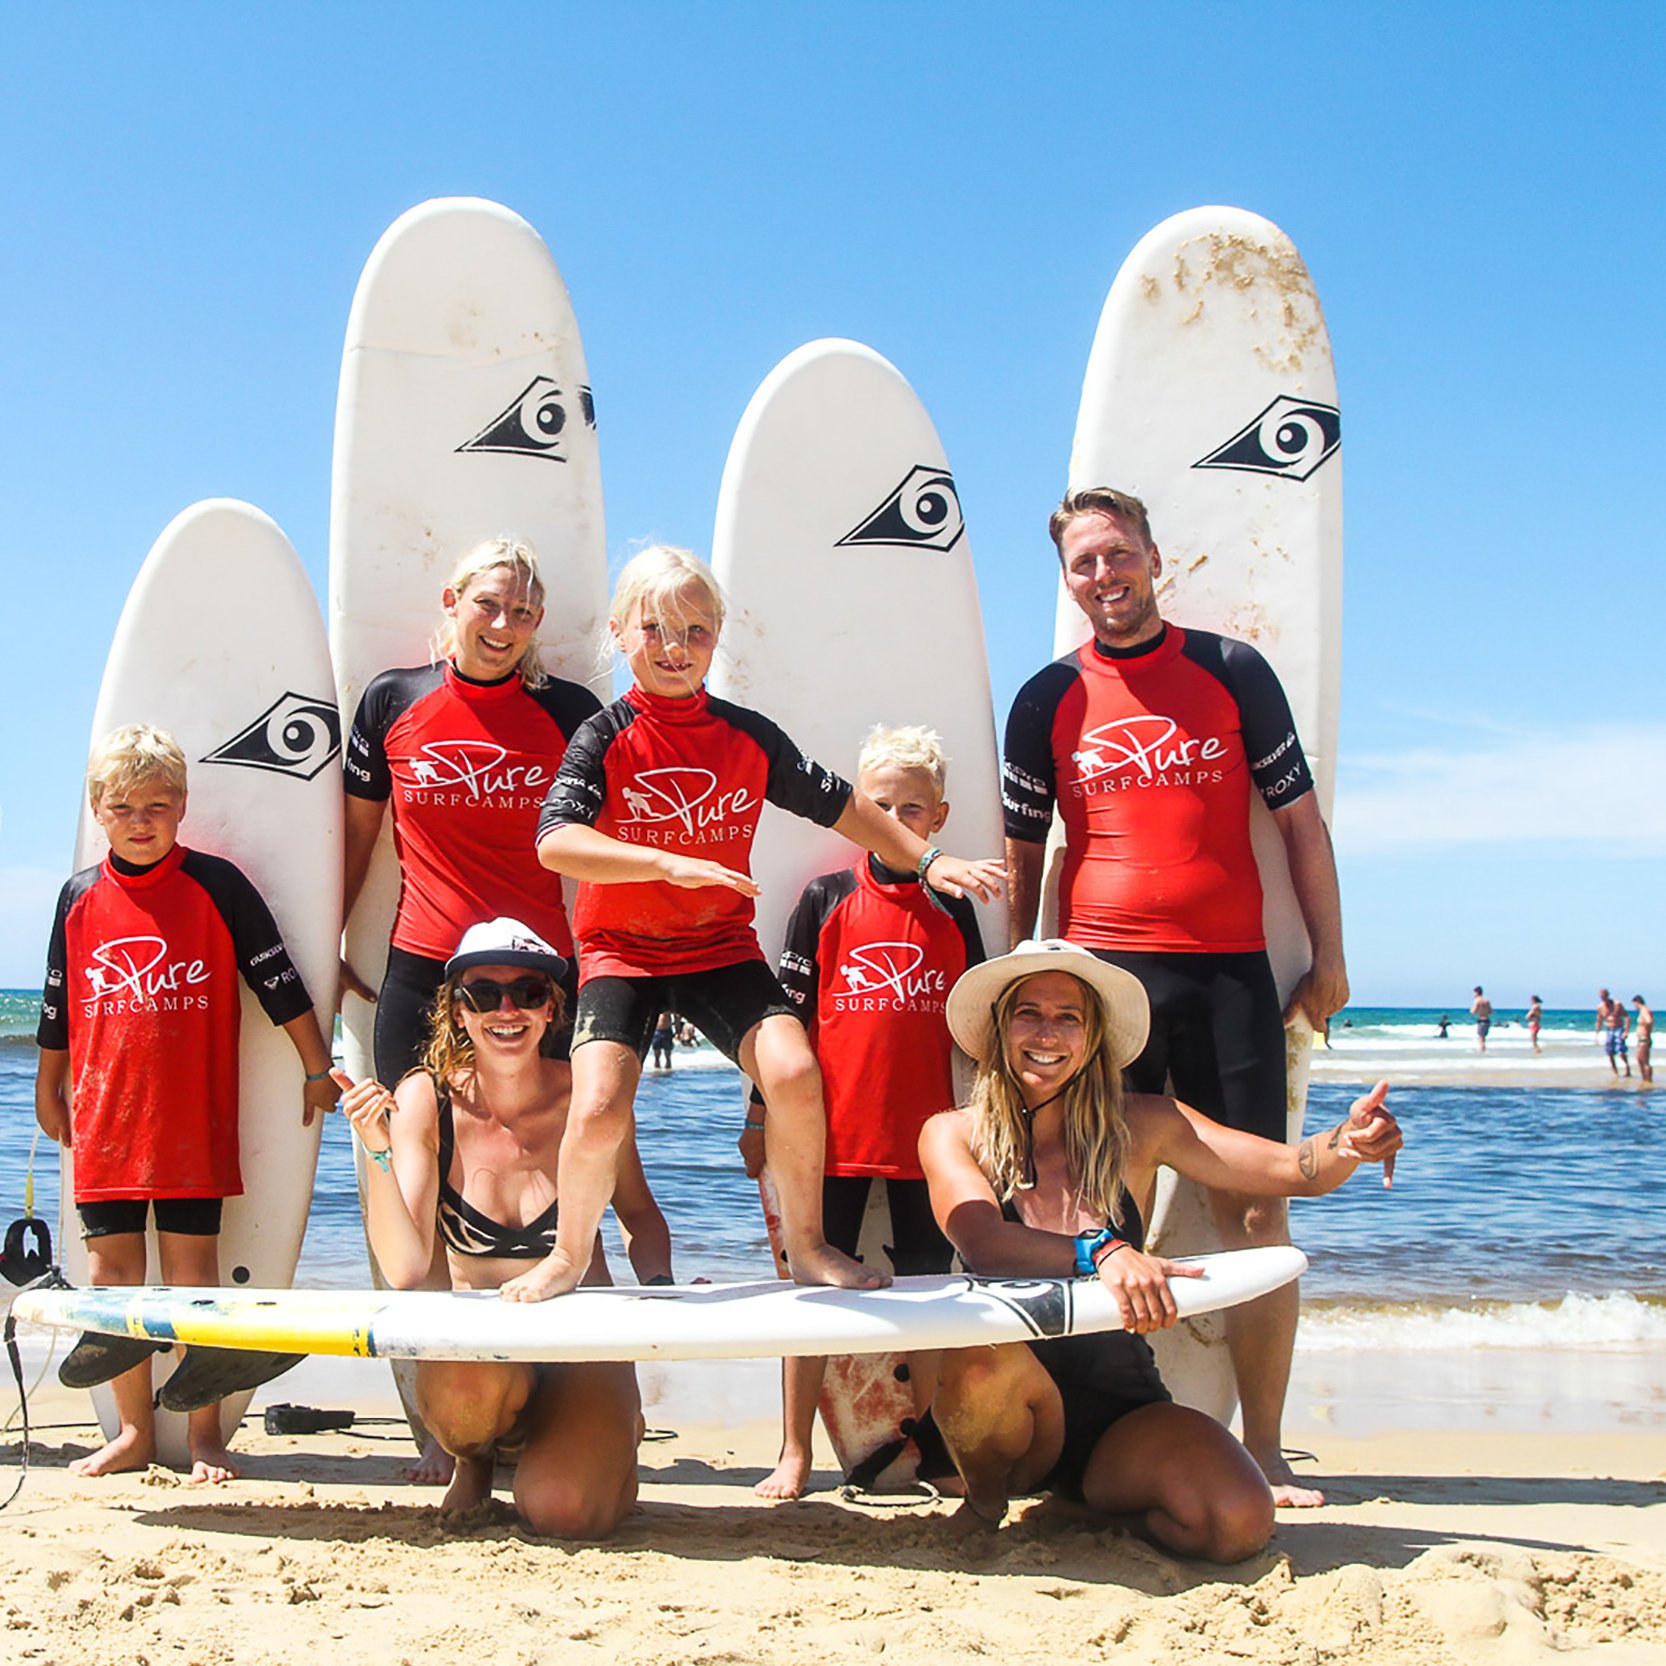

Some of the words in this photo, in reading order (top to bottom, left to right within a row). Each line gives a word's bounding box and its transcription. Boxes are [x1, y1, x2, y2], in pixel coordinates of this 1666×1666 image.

[401, 740, 549, 800] Pure
[1069, 715, 1229, 779] Pure
[404, 790, 543, 809] SURFCAMPS
[615, 767, 759, 836] Pure
[1072, 770, 1223, 798] SURFCAMPS
[1265, 762, 1301, 798] ROXY
[617, 824, 752, 845] SURFCAMPS
[80, 935, 212, 1004] Pure
[832, 941, 946, 1003] Pure
